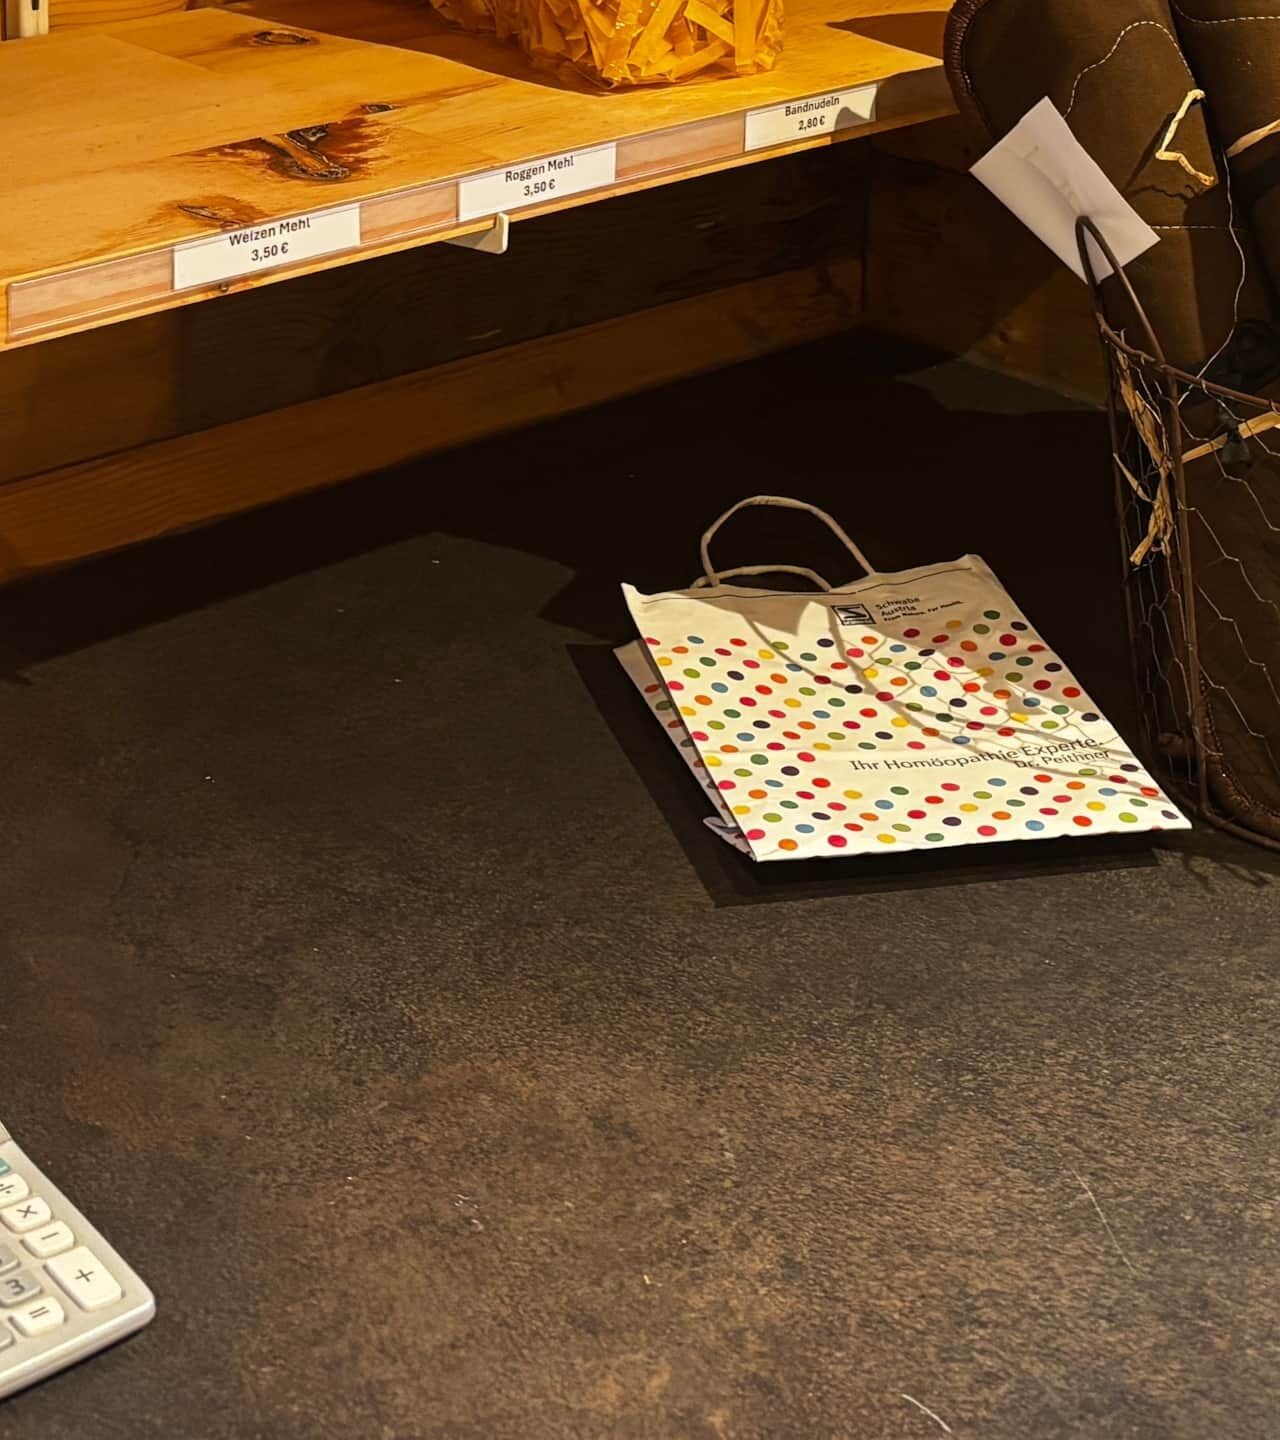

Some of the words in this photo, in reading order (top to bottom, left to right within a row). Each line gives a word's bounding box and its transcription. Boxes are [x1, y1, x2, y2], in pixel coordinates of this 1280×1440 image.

[785, 96, 840, 116] Bandnudeln
[798, 117, 818, 131] 2,80
[820, 116, 825, 125] €
[505, 165, 545, 183] Roggen
[548, 155, 574, 172] Mehl
[524, 181, 546, 197] 3,50
[549, 179, 556, 190] €
[229, 227, 276, 247] Weizen
[279, 217, 311, 235] Mehl
[252, 245, 278, 262] 3,50
[281, 243, 288, 254] €
[850, 760, 880, 771] Ihr
[884, 750, 1019, 770] Homöopathie
[1022, 739, 1104, 756] Experte.
[1013, 759, 1039, 769] Dr.
[1042, 749, 1110, 765] Peithner
[6, 1279, 25, 1296] 3
